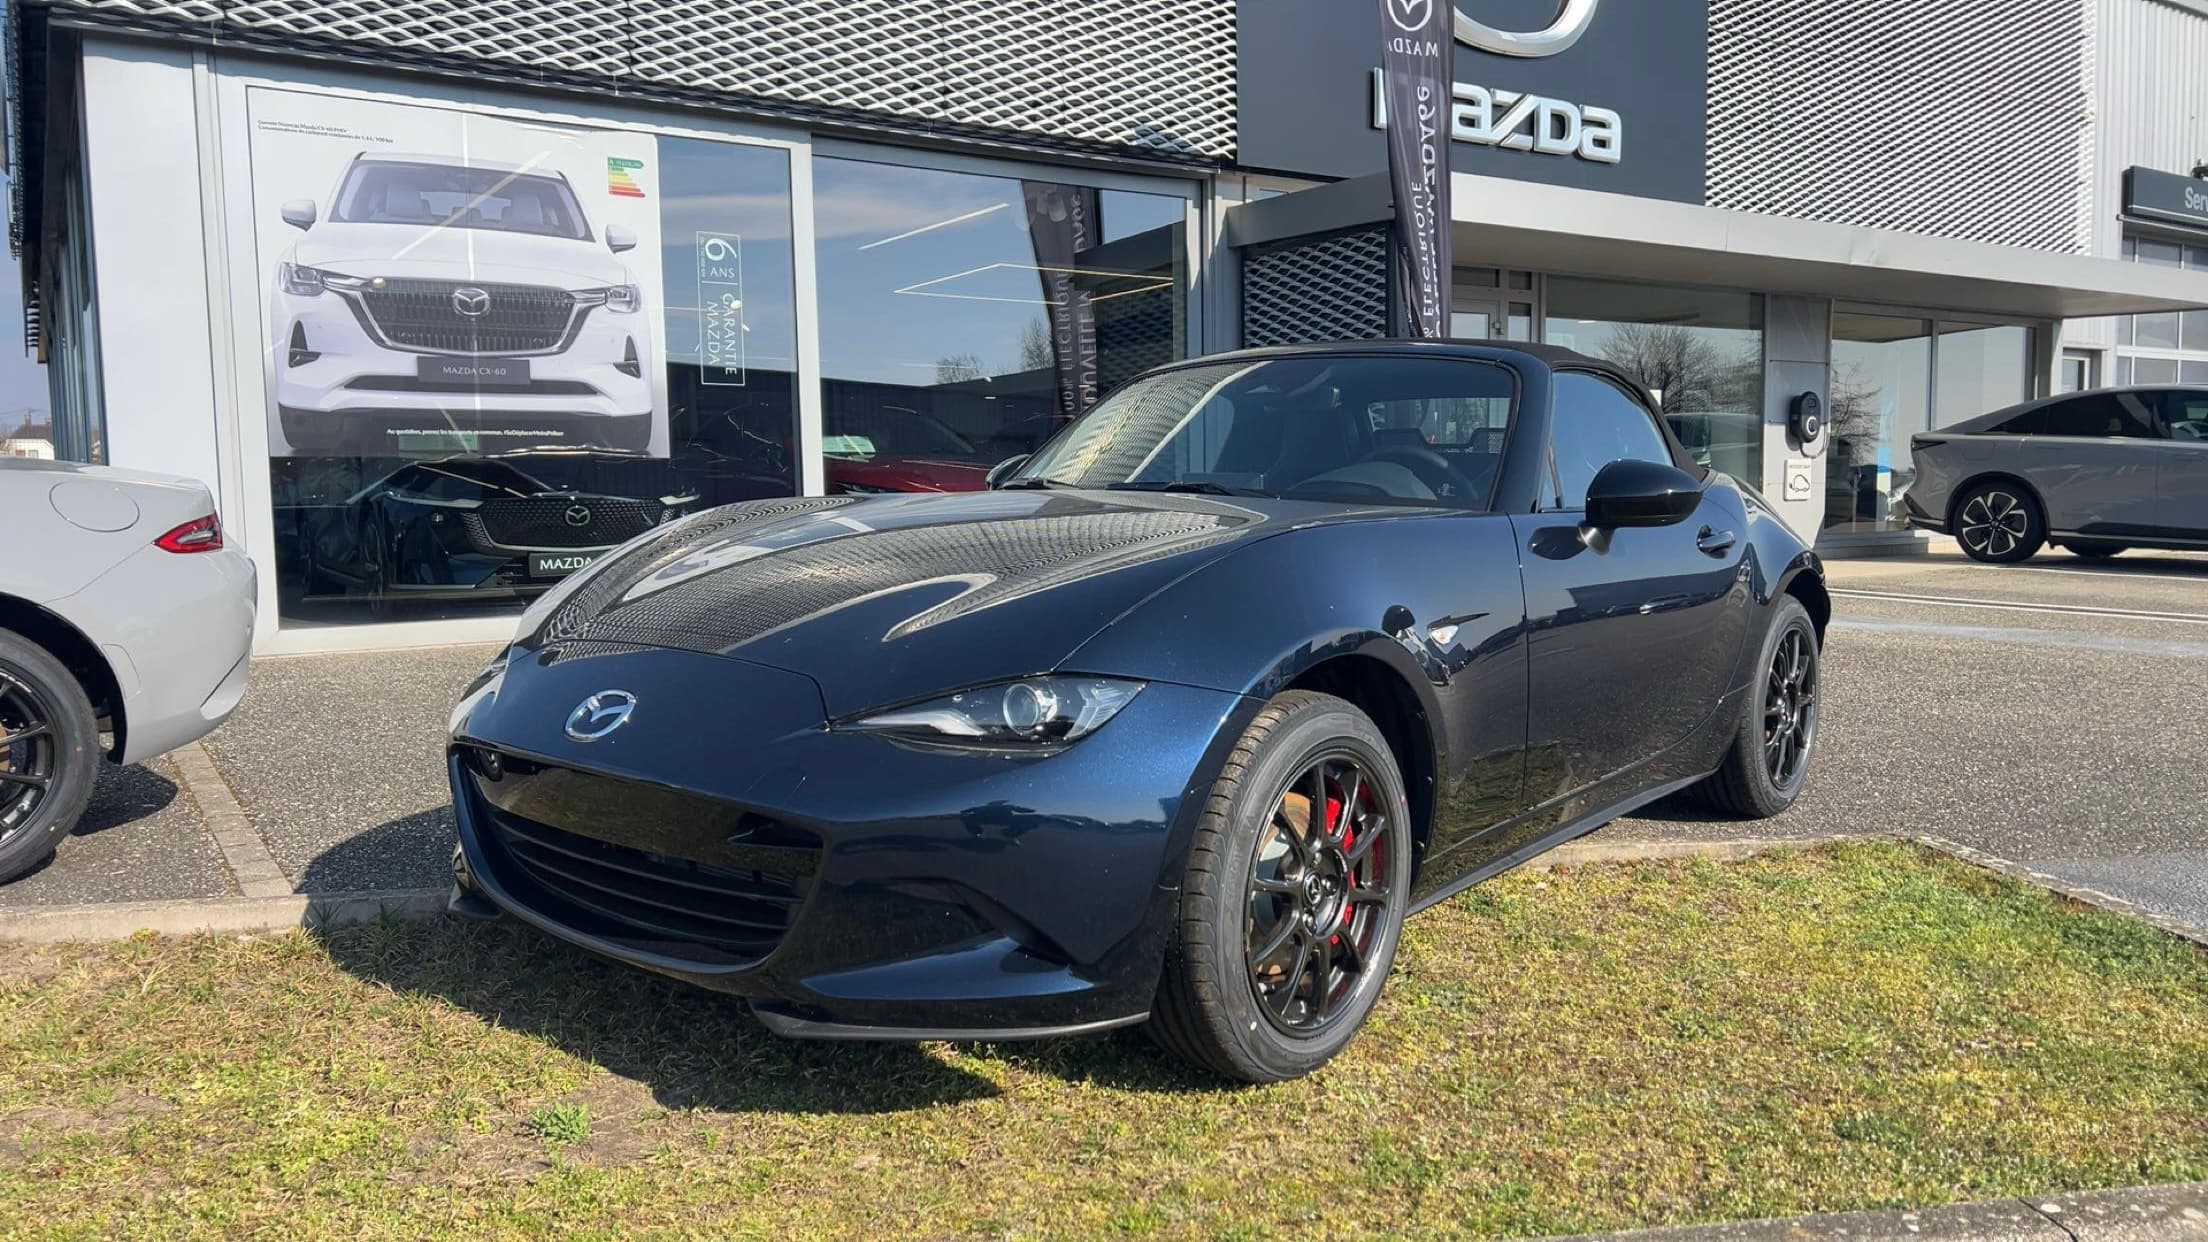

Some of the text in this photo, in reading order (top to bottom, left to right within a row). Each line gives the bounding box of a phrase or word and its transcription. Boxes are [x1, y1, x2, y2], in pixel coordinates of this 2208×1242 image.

[1374, 66, 1622, 164] azda
[705, 238, 737, 261] 6
[710, 267, 735, 278] ANS
[706, 301, 720, 365] MAZDA
[722, 293, 737, 375] GARANTIE
[443, 367, 507, 376] MAZDA CX-60
